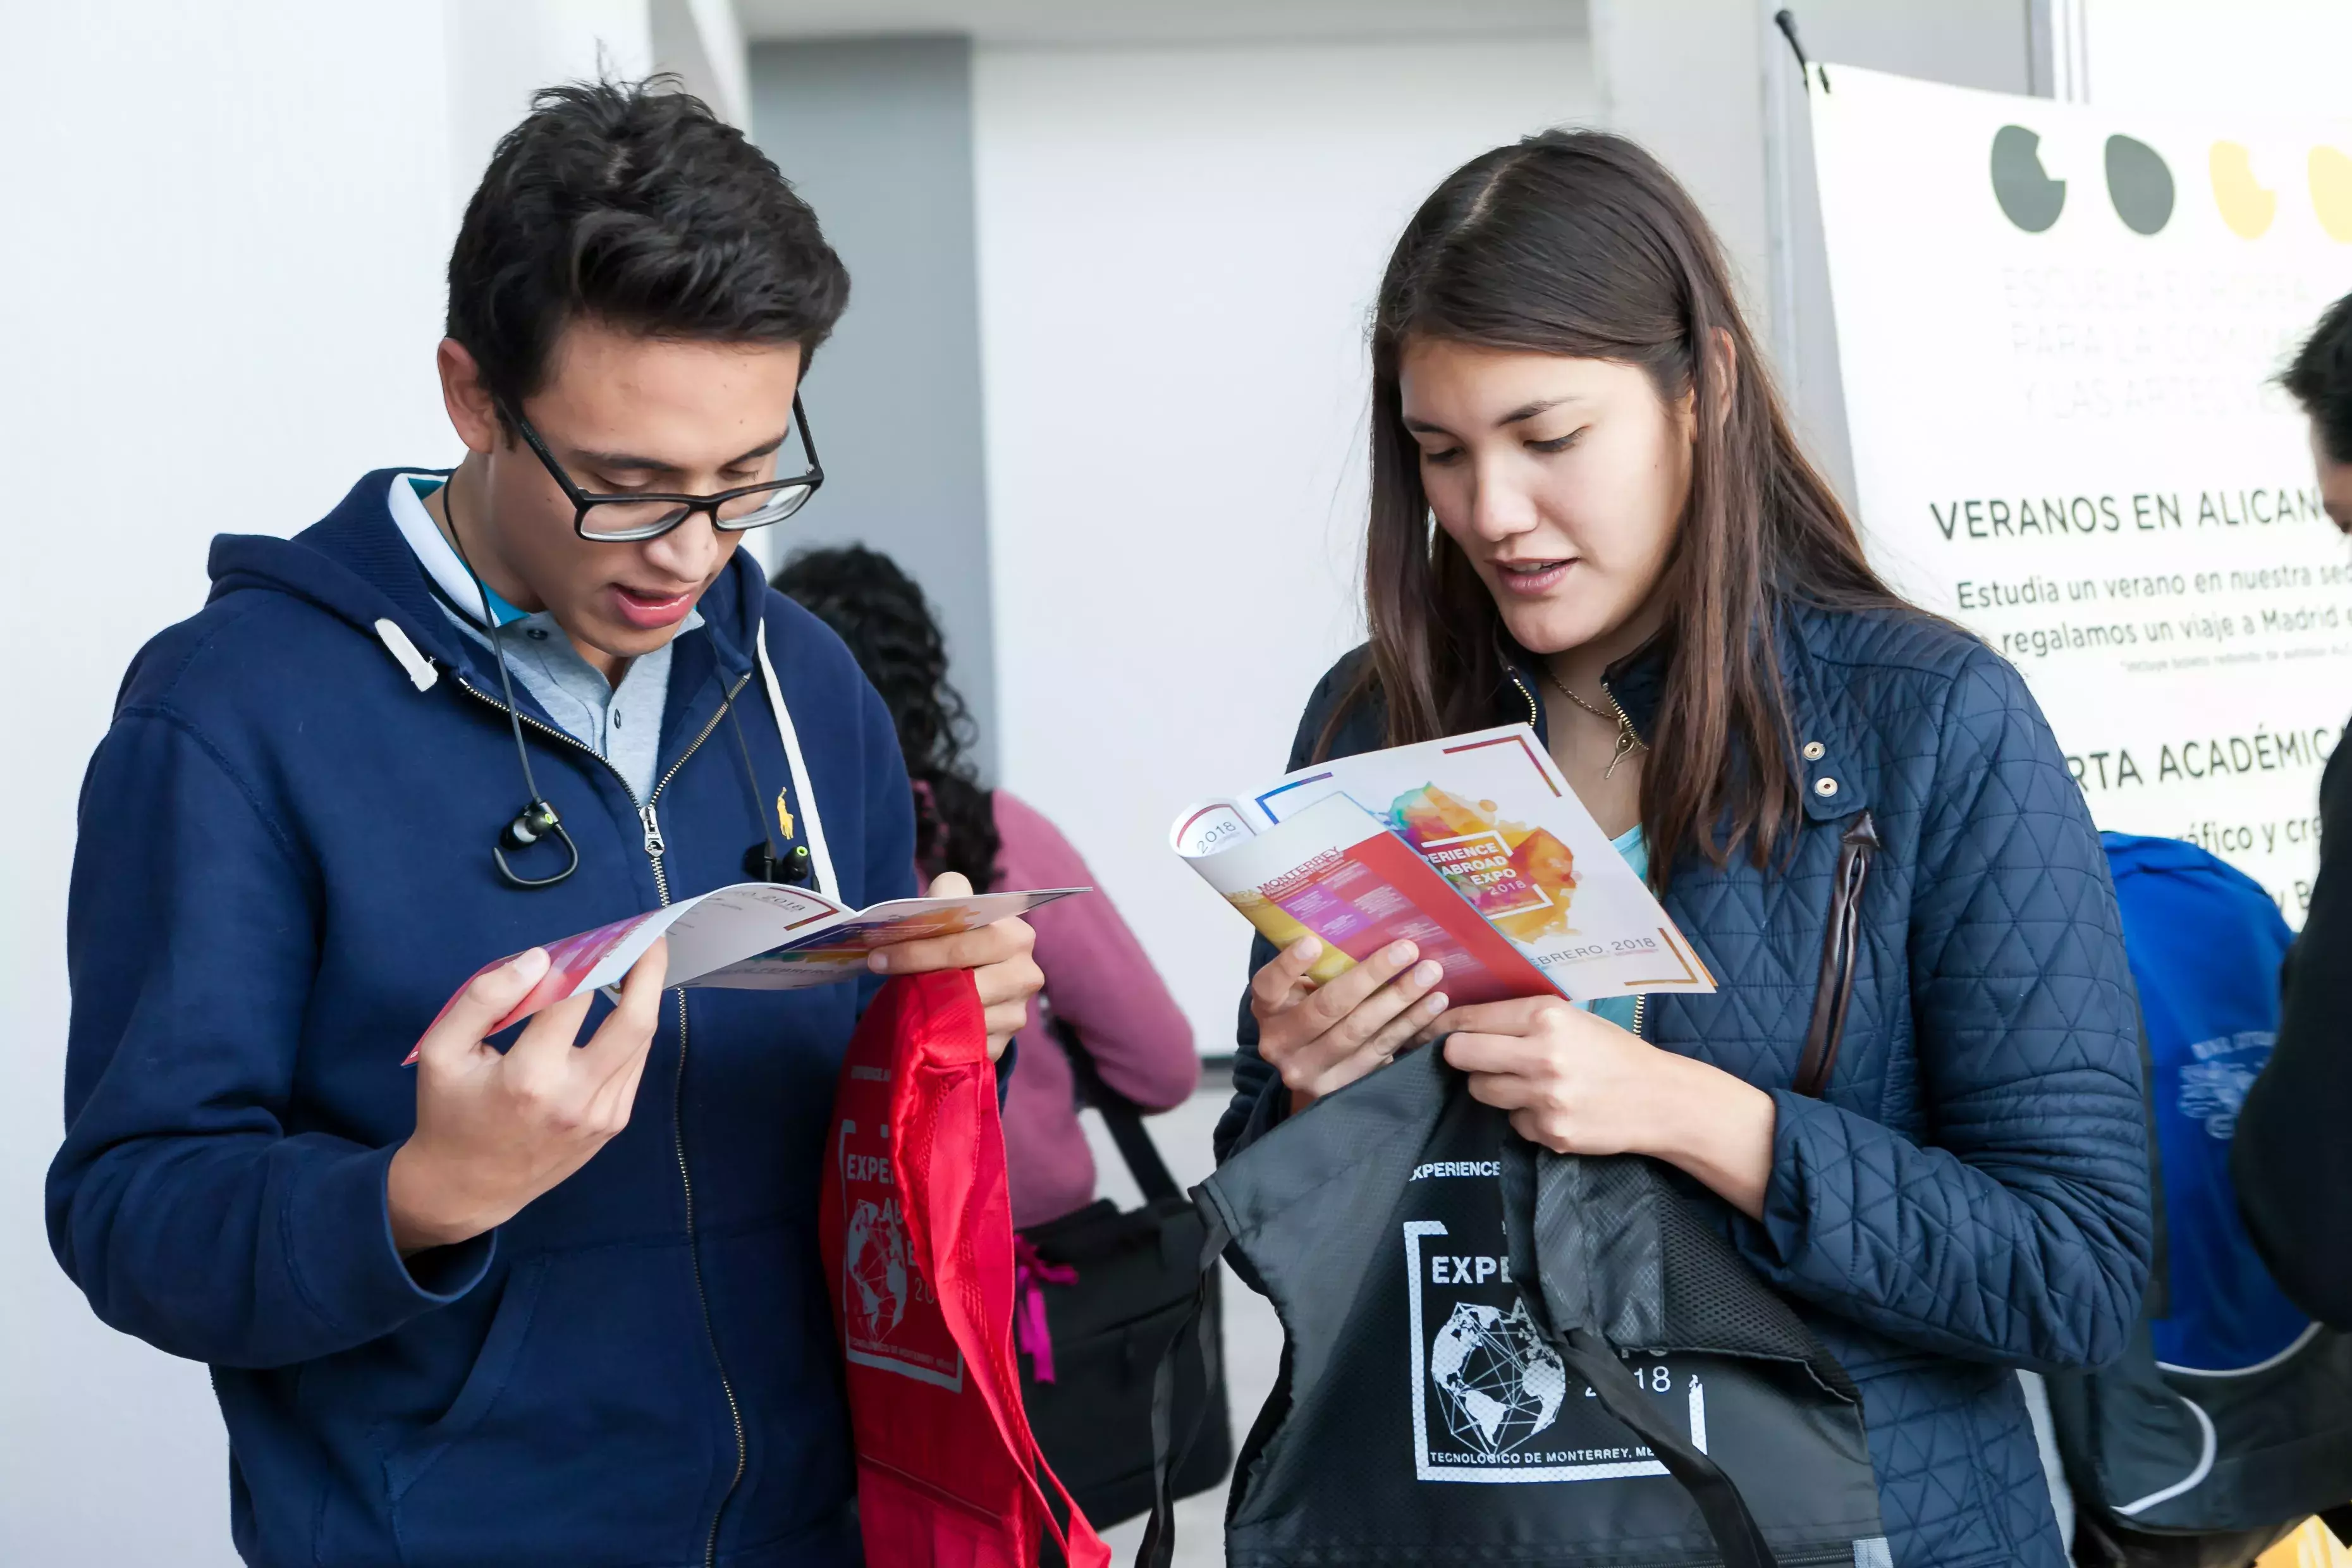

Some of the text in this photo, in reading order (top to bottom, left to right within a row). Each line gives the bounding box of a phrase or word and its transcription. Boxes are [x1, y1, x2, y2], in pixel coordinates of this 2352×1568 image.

[1930, 494, 2120, 542] VERANOS
[2133, 493, 2183, 531] EN
[1957, 575, 2059, 611] Estudia
[2067, 579, 2097, 601] un
[2104, 574, 2185, 599] verano
[2195, 572, 2222, 595] en
[2230, 565, 2312, 591] nuestra
[2002, 622, 2138, 658] regalamos
[2143, 621, 2174, 642] un
[2179, 611, 2234, 644] viaje
[2243, 615, 2255, 635] a
[2261, 604, 2339, 634] Madrid
[2159, 722, 2348, 783] ACADÉMIC
[1196, 821, 1236, 854] 2018
[2177, 822, 2253, 854] áfico
[2262, 823, 2275, 854] y
[1441, 855, 1509, 877] ABROAD
[1469, 867, 1517, 886] EXPO
[1488, 879, 1527, 895] 2018
[1611, 937, 1657, 950] 2018
[847, 1153, 894, 1185] EXPE
[1430, 1451, 1521, 1465] TECNOLOGICO
[1524, 1452, 1542, 1464] DE
